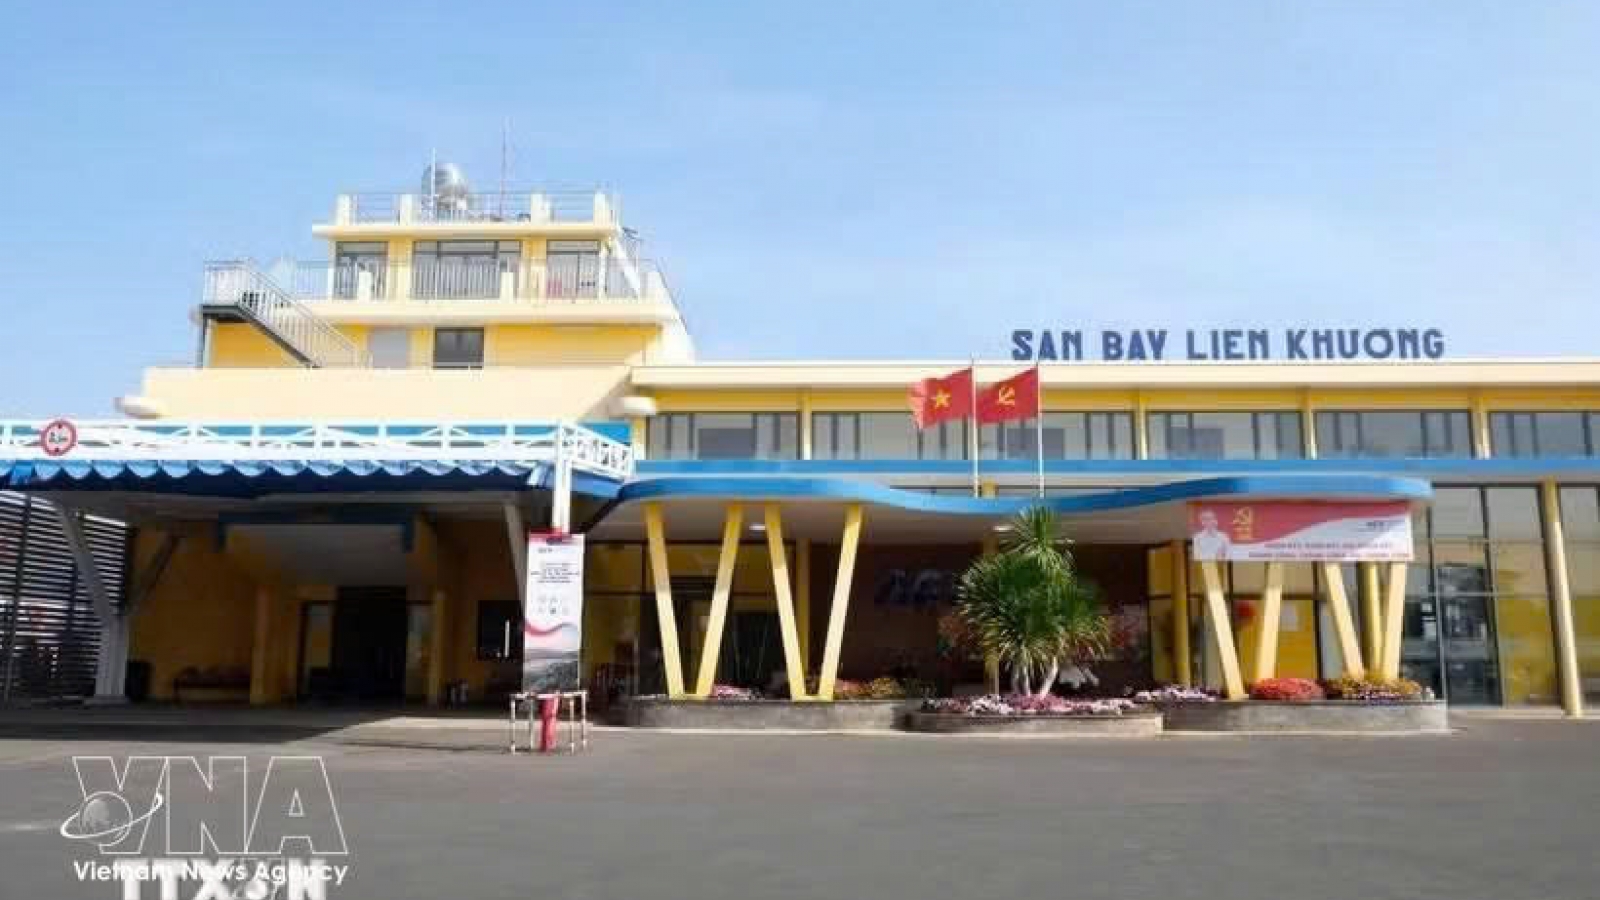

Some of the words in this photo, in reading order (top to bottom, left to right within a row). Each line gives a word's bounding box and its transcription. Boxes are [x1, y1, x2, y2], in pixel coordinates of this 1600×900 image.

[1012, 329, 1083, 360] SAN
[1102, 329, 1167, 360] BAY
[1186, 329, 1268, 360] LIEN
